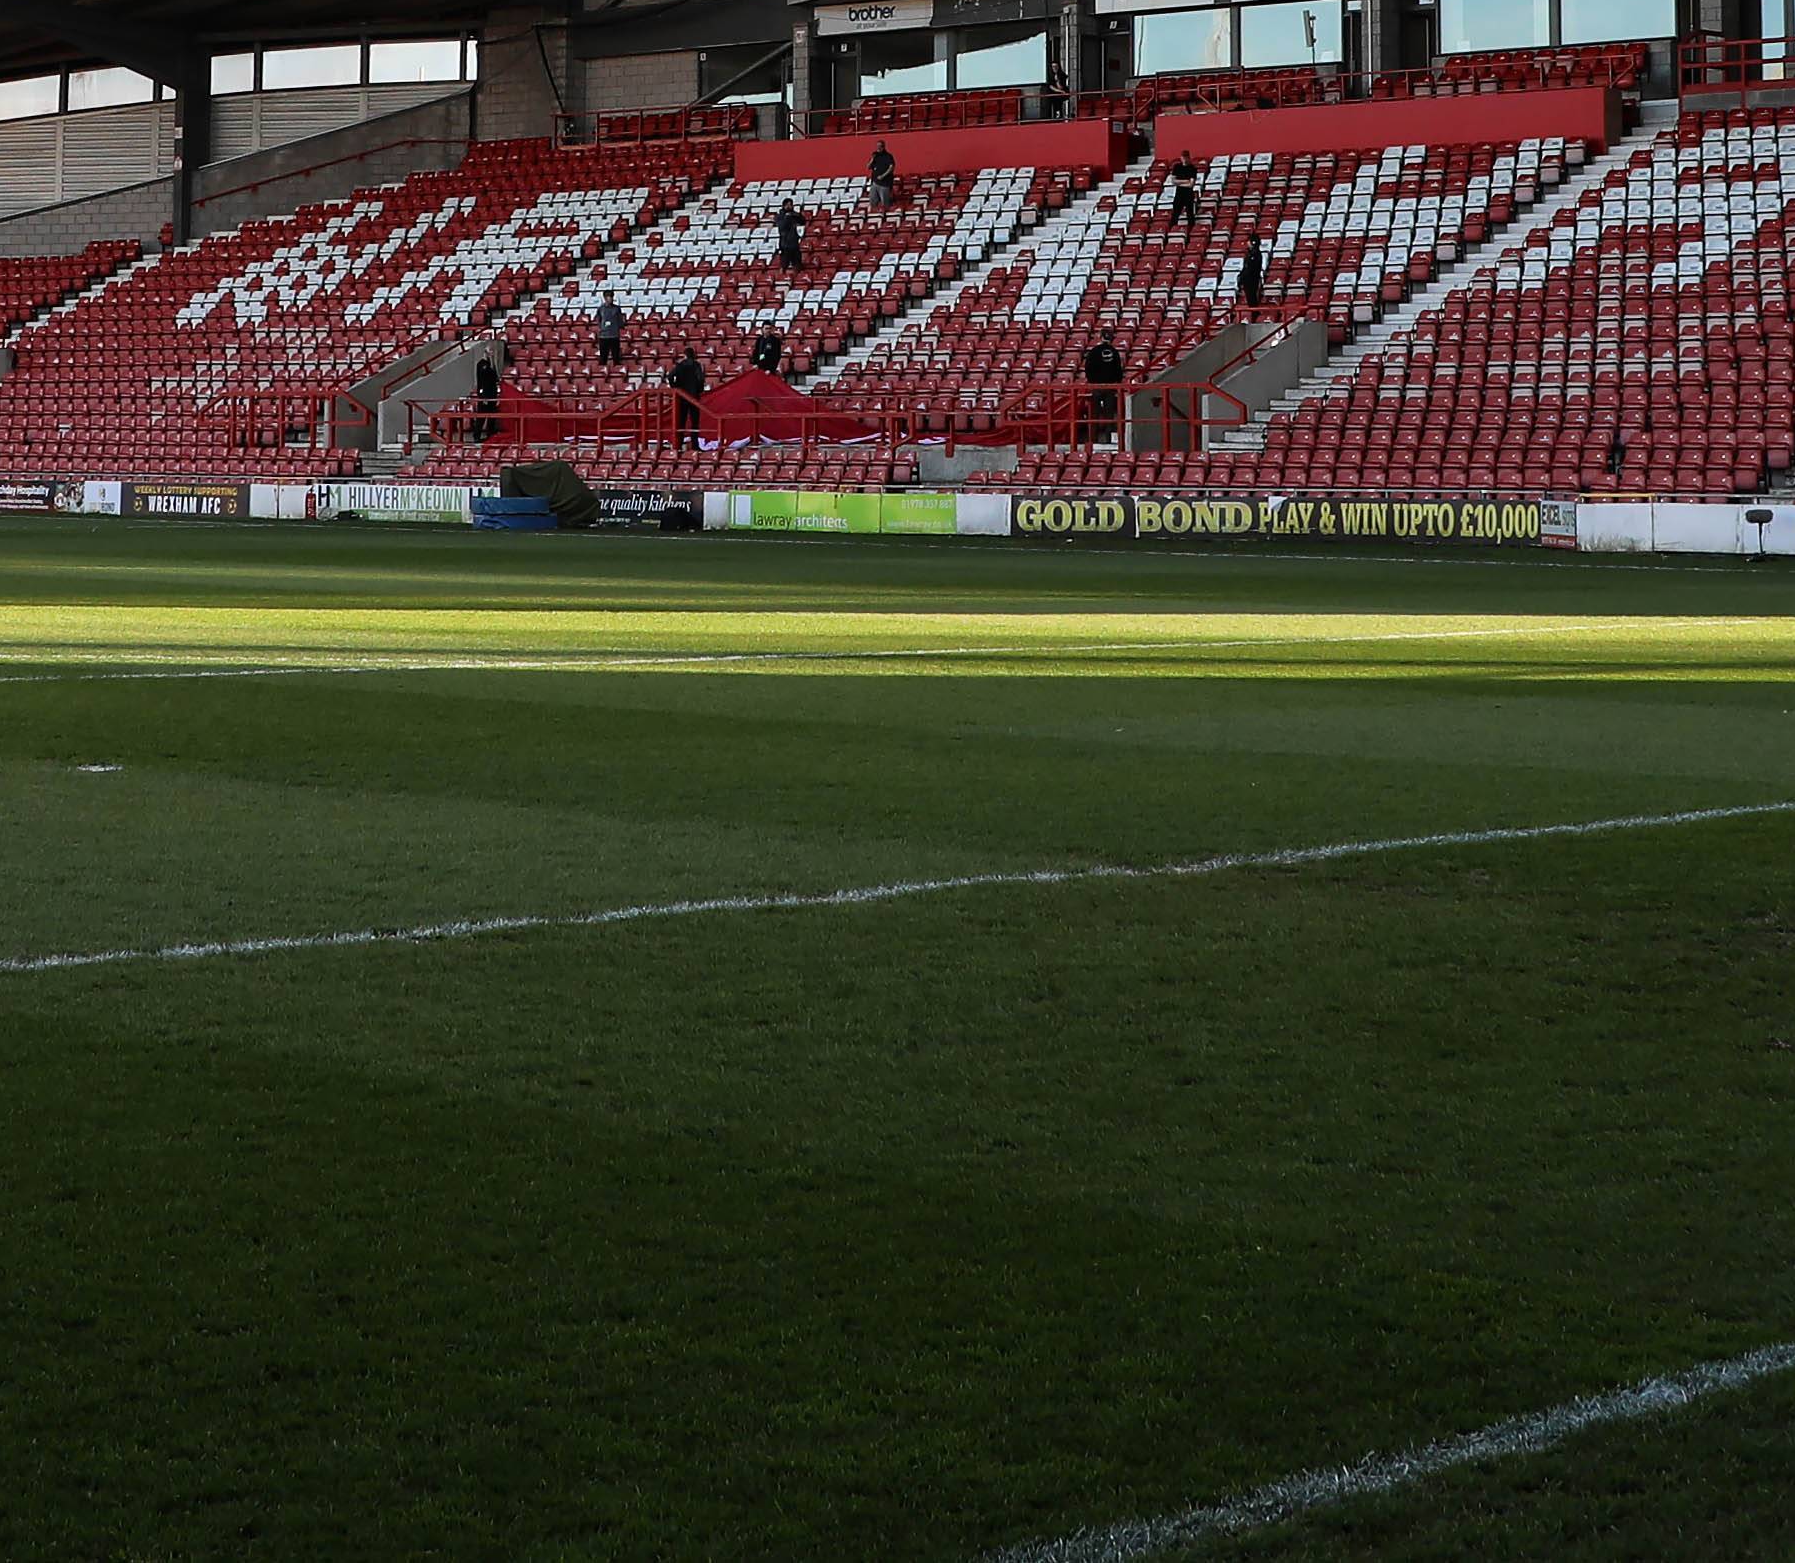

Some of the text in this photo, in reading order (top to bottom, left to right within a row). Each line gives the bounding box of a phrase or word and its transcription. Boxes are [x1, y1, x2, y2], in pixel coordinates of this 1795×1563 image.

[849, 5, 895, 21] brother
[17, 486, 50, 498] Hospitality
[134, 486, 238, 496] WEEKLY LOTTERY SUPPORTING
[148, 496, 221, 515] WREXHAM AFC
[610, 494, 648, 516] quality
[754, 512, 848, 529] lawray architects
[1016, 500, 1125, 532] GOLD
[1137, 501, 1253, 534] BOND
[1258, 502, 1314, 534] PLAY
[1319, 502, 1336, 535] &
[1340, 502, 1388, 535] WIN
[1460, 504, 1538, 544] £10,000
